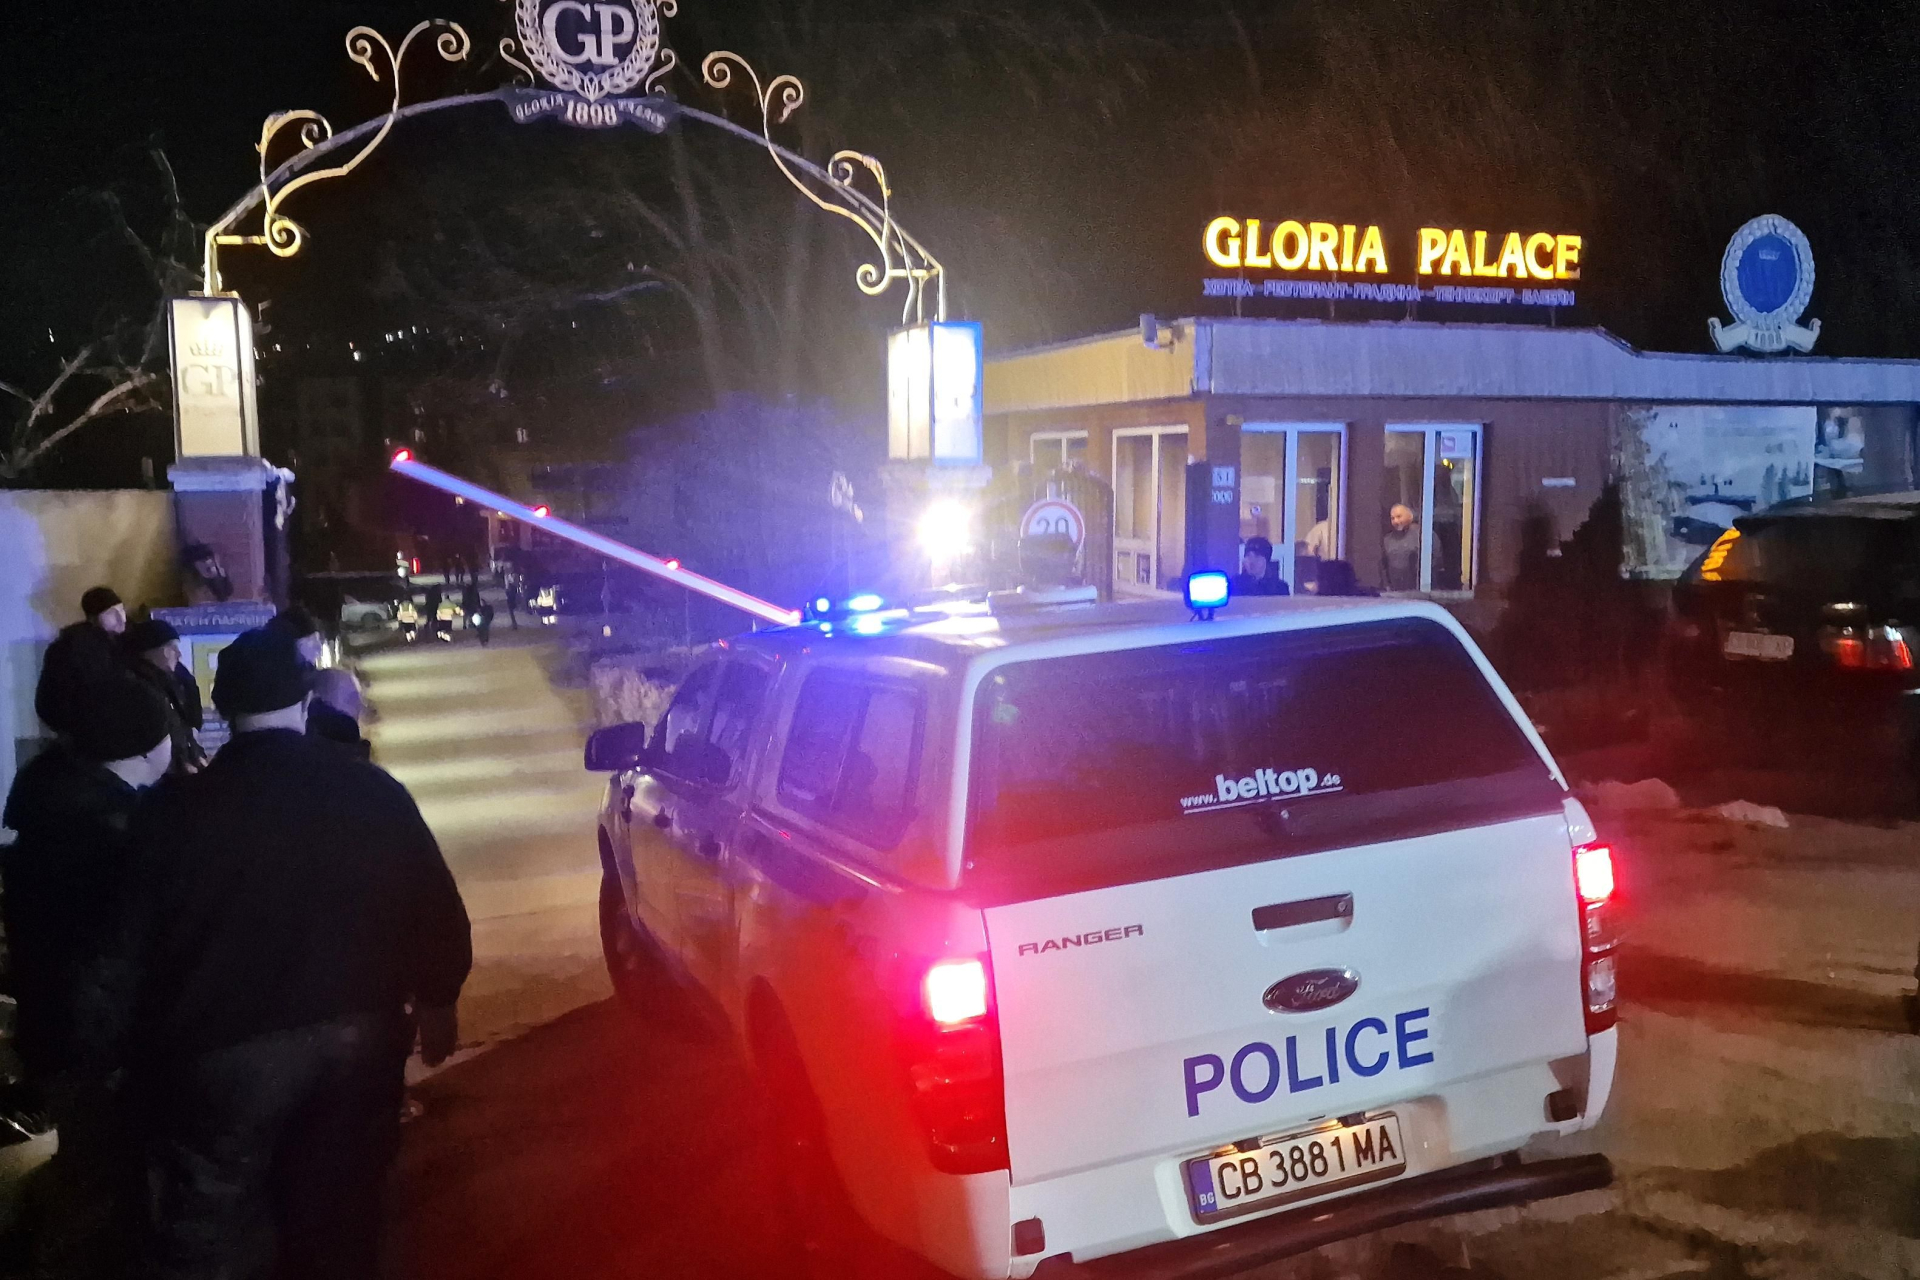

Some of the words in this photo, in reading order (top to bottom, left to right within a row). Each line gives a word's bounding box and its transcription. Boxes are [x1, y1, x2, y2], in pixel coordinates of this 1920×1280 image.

[543, 1, 635, 66] GP
[1203, 216, 1389, 273] GLORIA
[1417, 227, 1582, 280] PALACE
[180, 364, 238, 397] GP
[1018, 924, 1144, 956] RANGER
[1183, 1007, 1434, 1118] POLICE
[1217, 1157, 1263, 1200] CB
[1269, 1136, 1346, 1188] 3881
[1352, 1125, 1397, 1168] MA
[1200, 1192, 1215, 1206] BG
